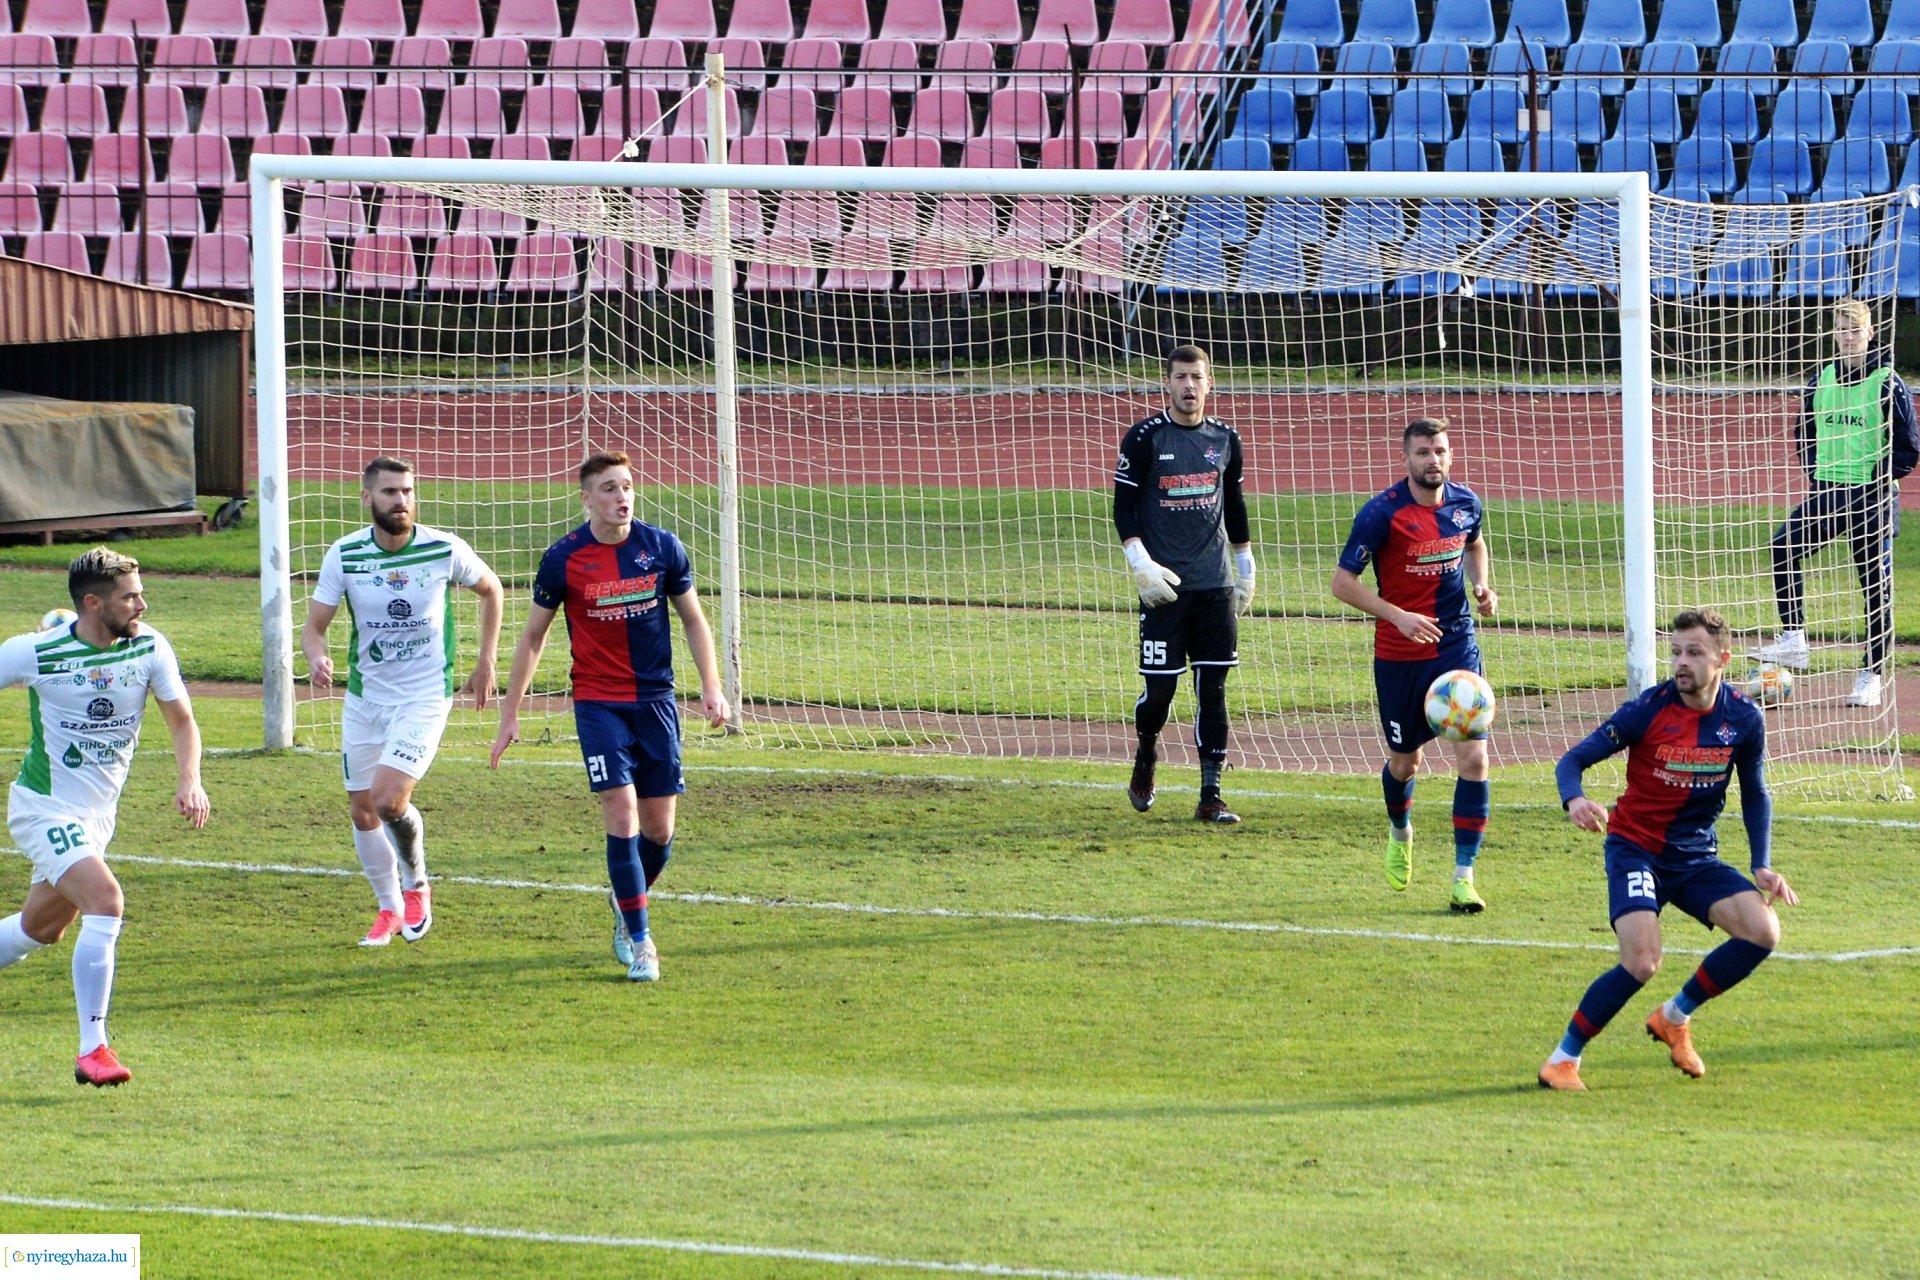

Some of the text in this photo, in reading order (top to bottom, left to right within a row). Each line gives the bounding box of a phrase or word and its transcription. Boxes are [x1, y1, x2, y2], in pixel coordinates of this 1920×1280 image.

[380, 636, 431, 649] FINO FRISS
[1143, 640, 1167, 665] 95
[60, 715, 136, 730] SZABADICS
[1389, 720, 1403, 744] 3
[79, 740, 106, 750] FINO
[588, 754, 609, 783] 21
[47, 823, 89, 856] 92
[1627, 871, 1656, 900] 22
